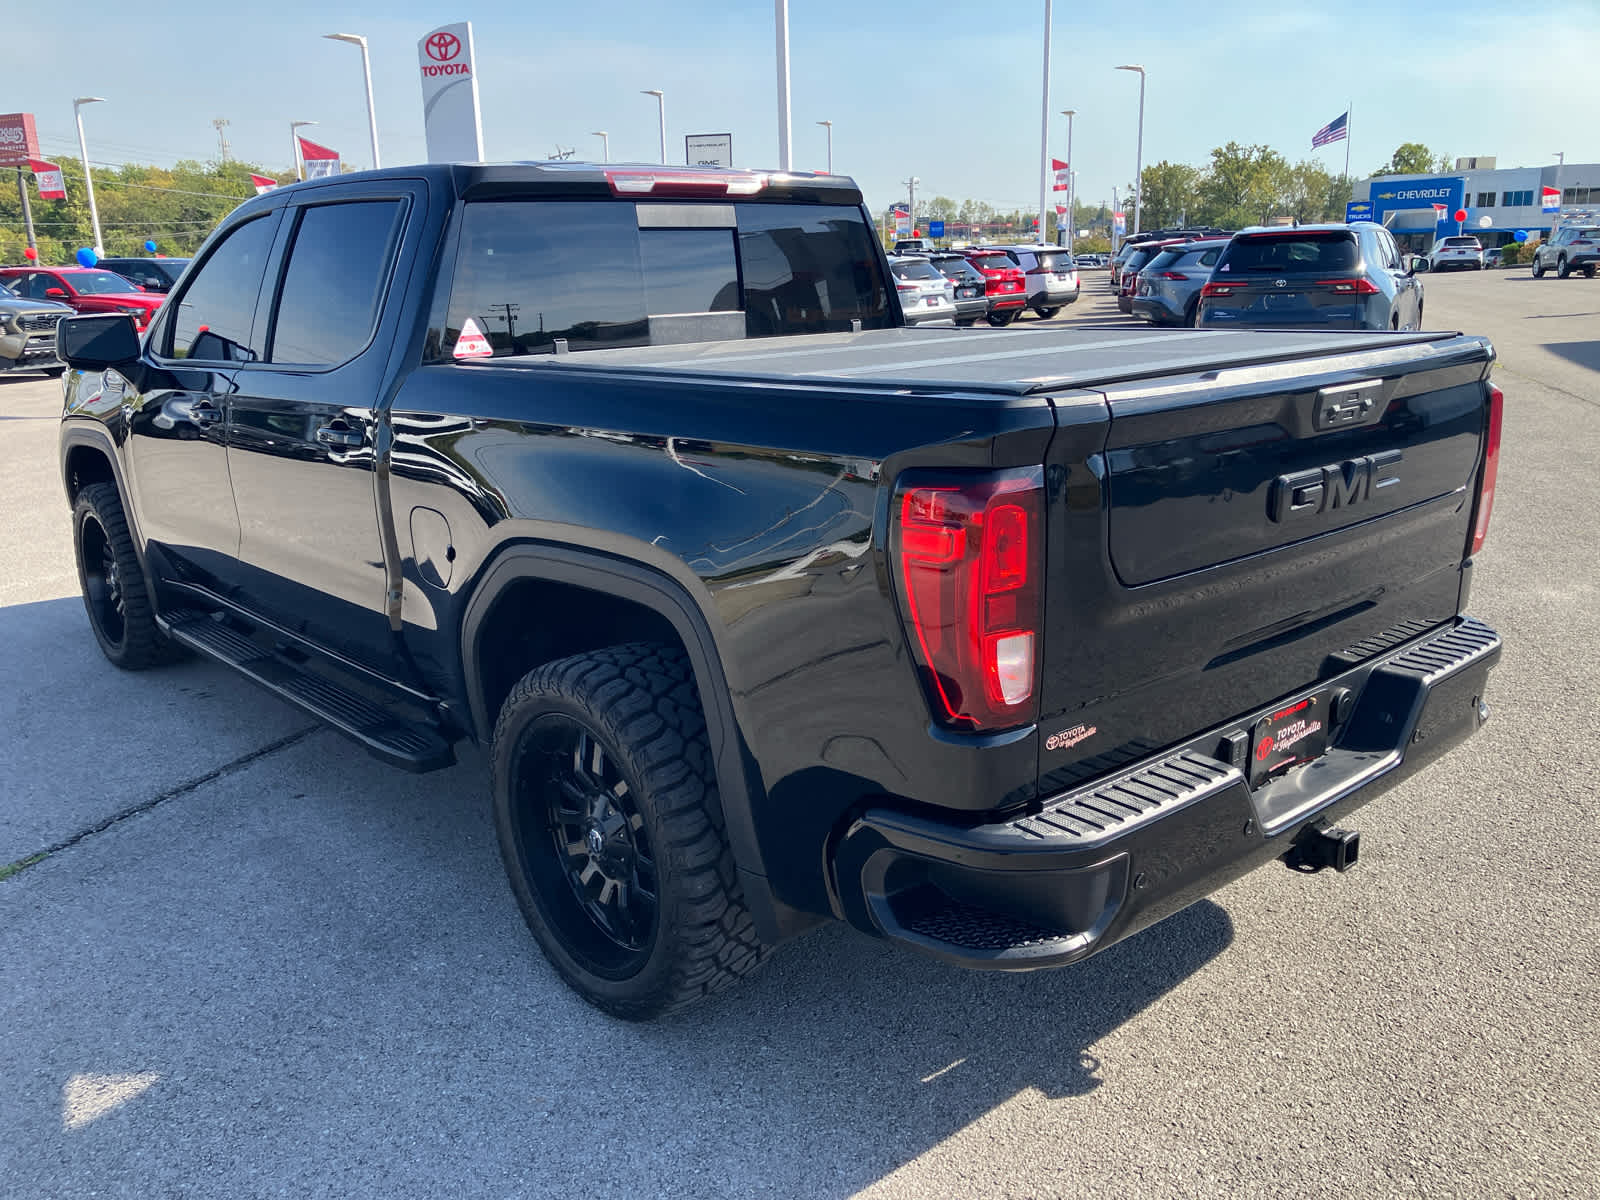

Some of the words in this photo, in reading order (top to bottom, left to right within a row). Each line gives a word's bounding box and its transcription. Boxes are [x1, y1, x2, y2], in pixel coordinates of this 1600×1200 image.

[422, 63, 470, 77] TOYOTA
[1397, 188, 1451, 200] CHEVROLET
[1267, 449, 1402, 523] GMC
[1059, 726, 1085, 741] TOYOTA
[1278, 720, 1305, 740] TOYOTA
